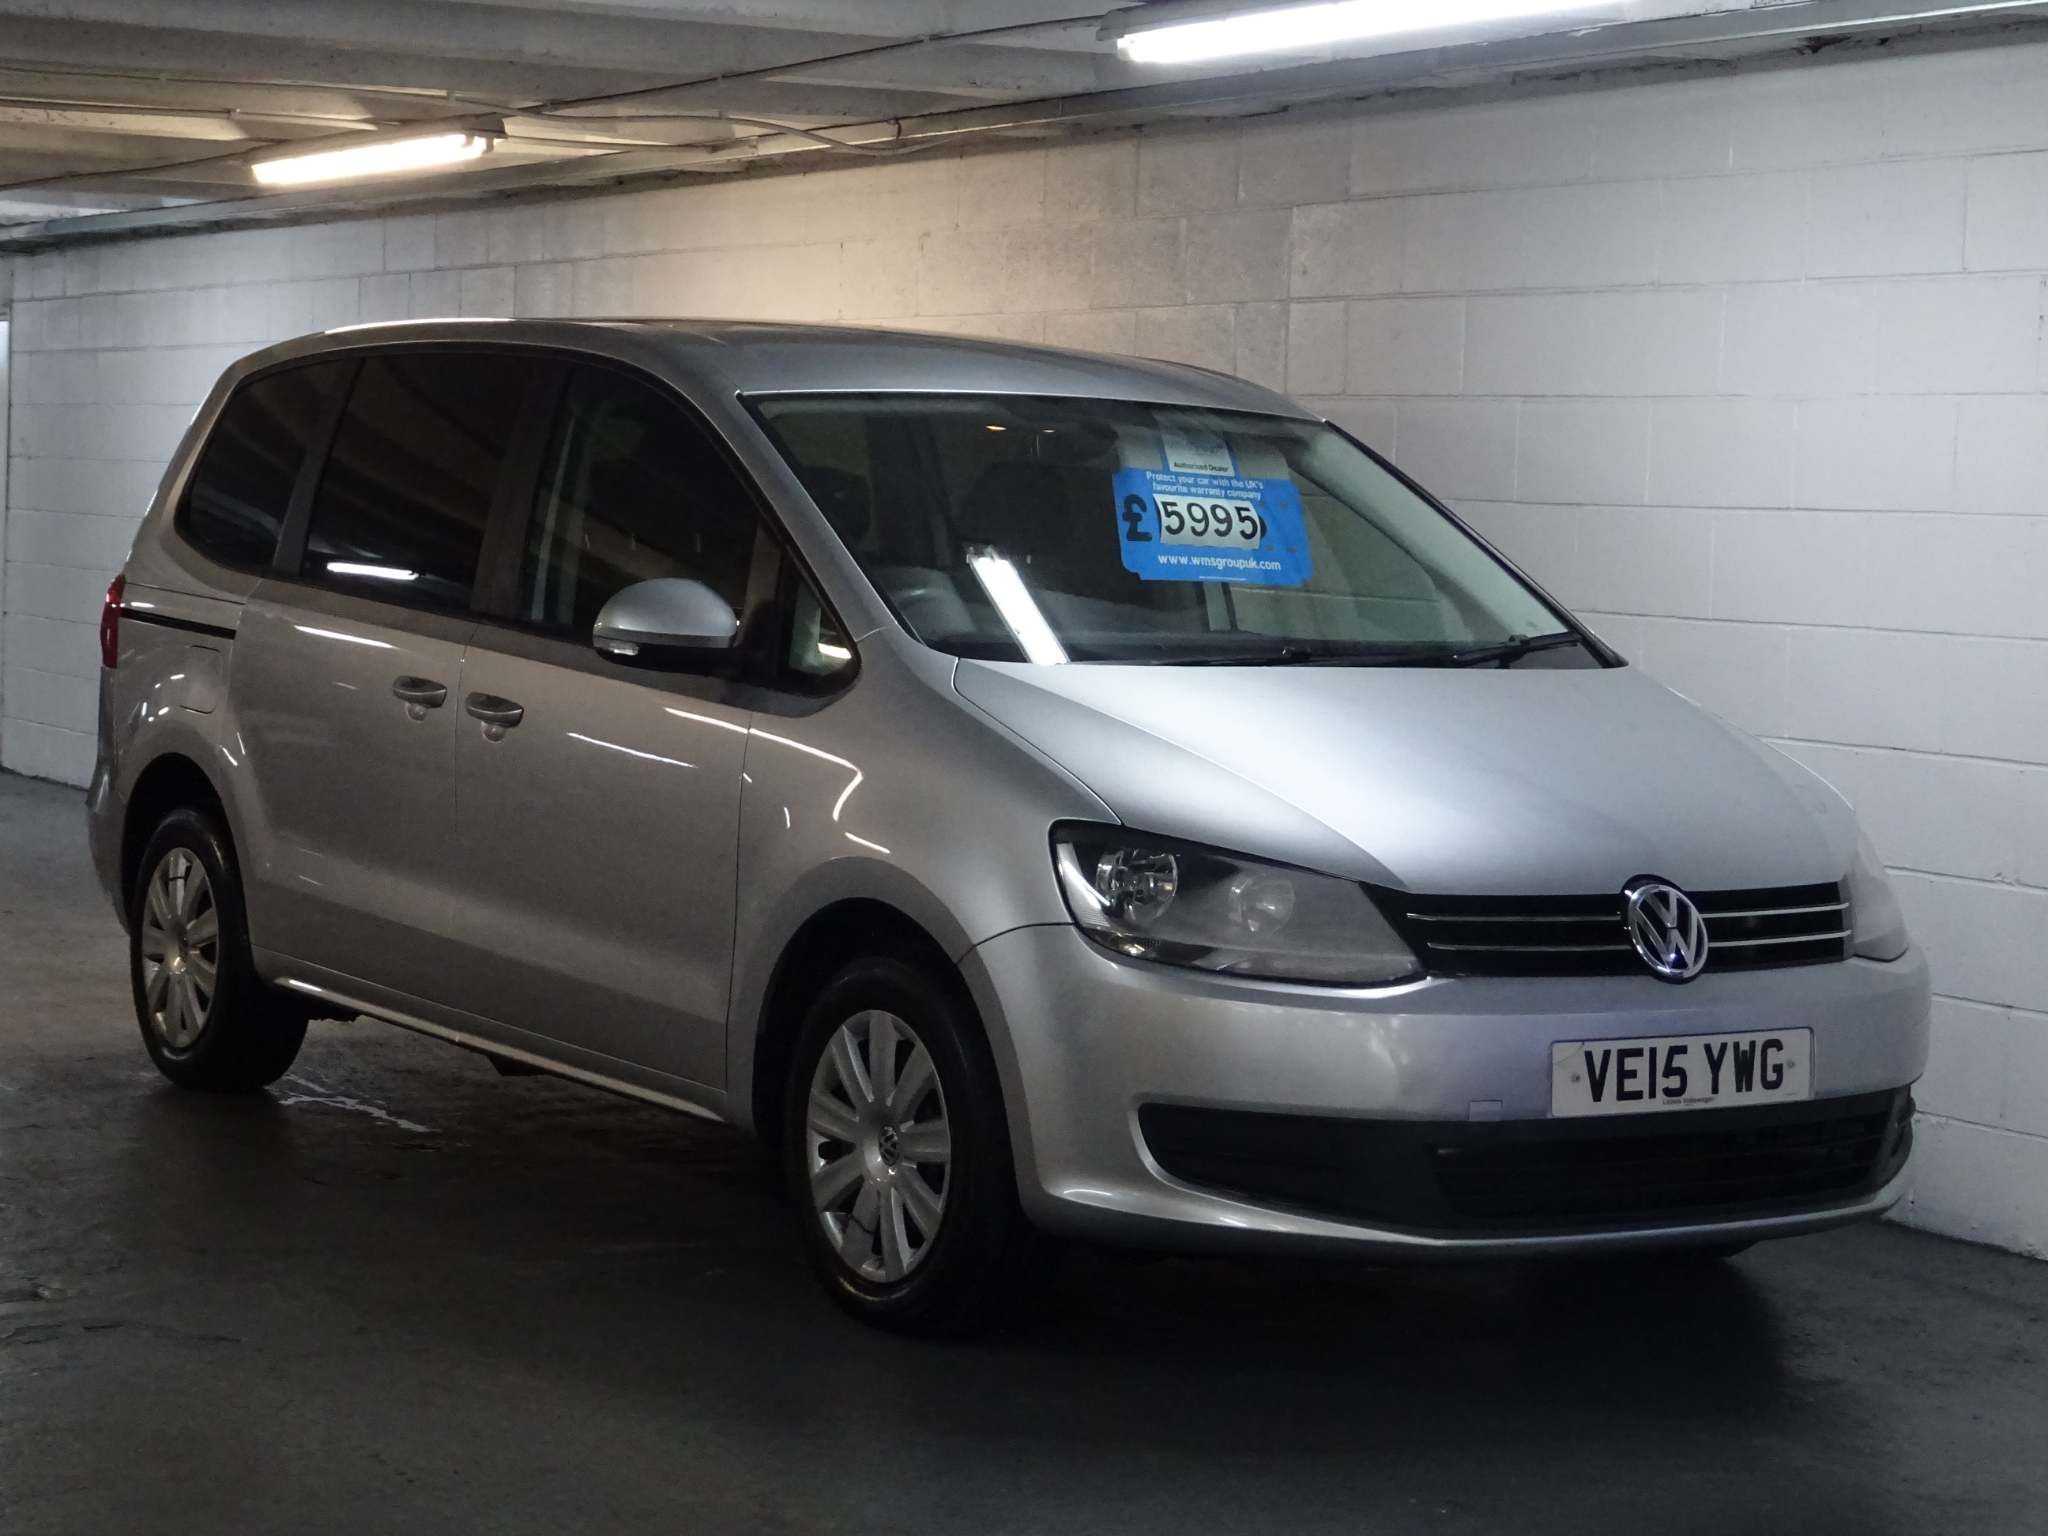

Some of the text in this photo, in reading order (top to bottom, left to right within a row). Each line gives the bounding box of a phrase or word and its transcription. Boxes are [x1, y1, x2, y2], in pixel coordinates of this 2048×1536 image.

[1146, 471, 1264, 489] Protect your car with the UK's
[1153, 481, 1262, 501] favourite warranty company
[1158, 554, 1281, 571] www.wmsgroupuk.com
[1584, 1038, 1784, 1103] VE15 YWG
